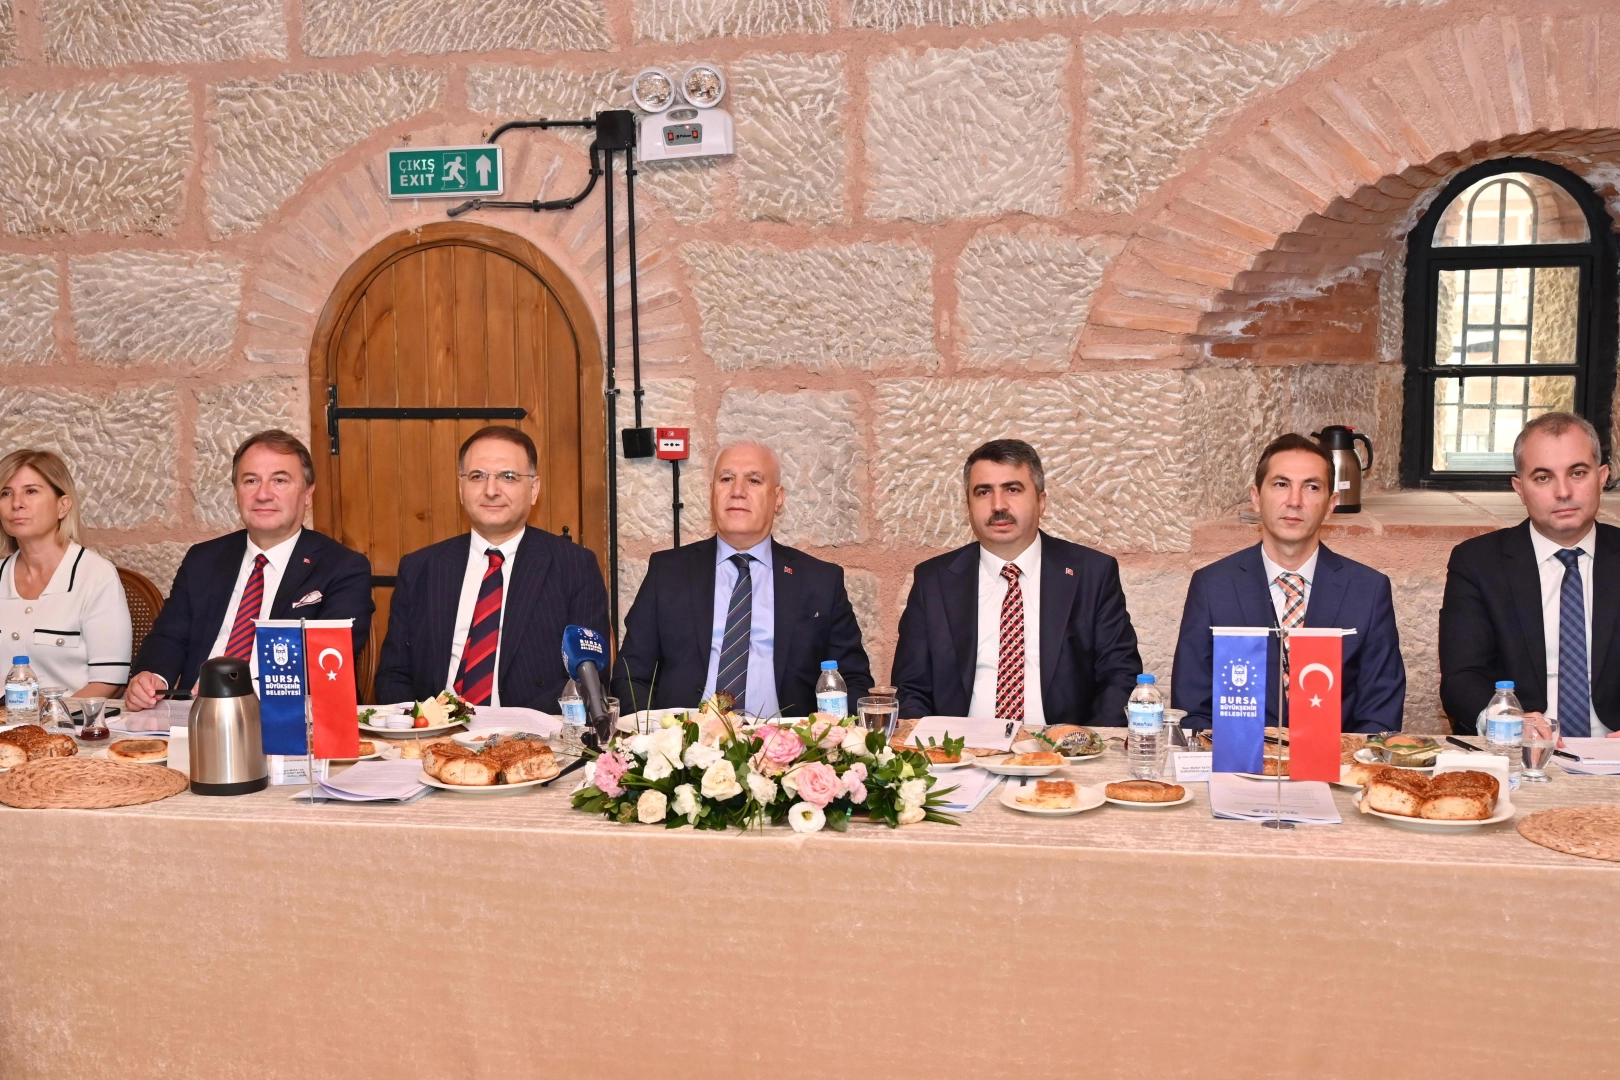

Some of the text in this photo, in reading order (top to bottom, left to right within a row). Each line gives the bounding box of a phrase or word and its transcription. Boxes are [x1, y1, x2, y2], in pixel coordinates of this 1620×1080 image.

[399, 159, 435, 173] ÇIKIŞ
[400, 174, 434, 187] EXIT
[265, 675, 300, 683] BURSA
[1220, 696, 1257, 705] BURSA
